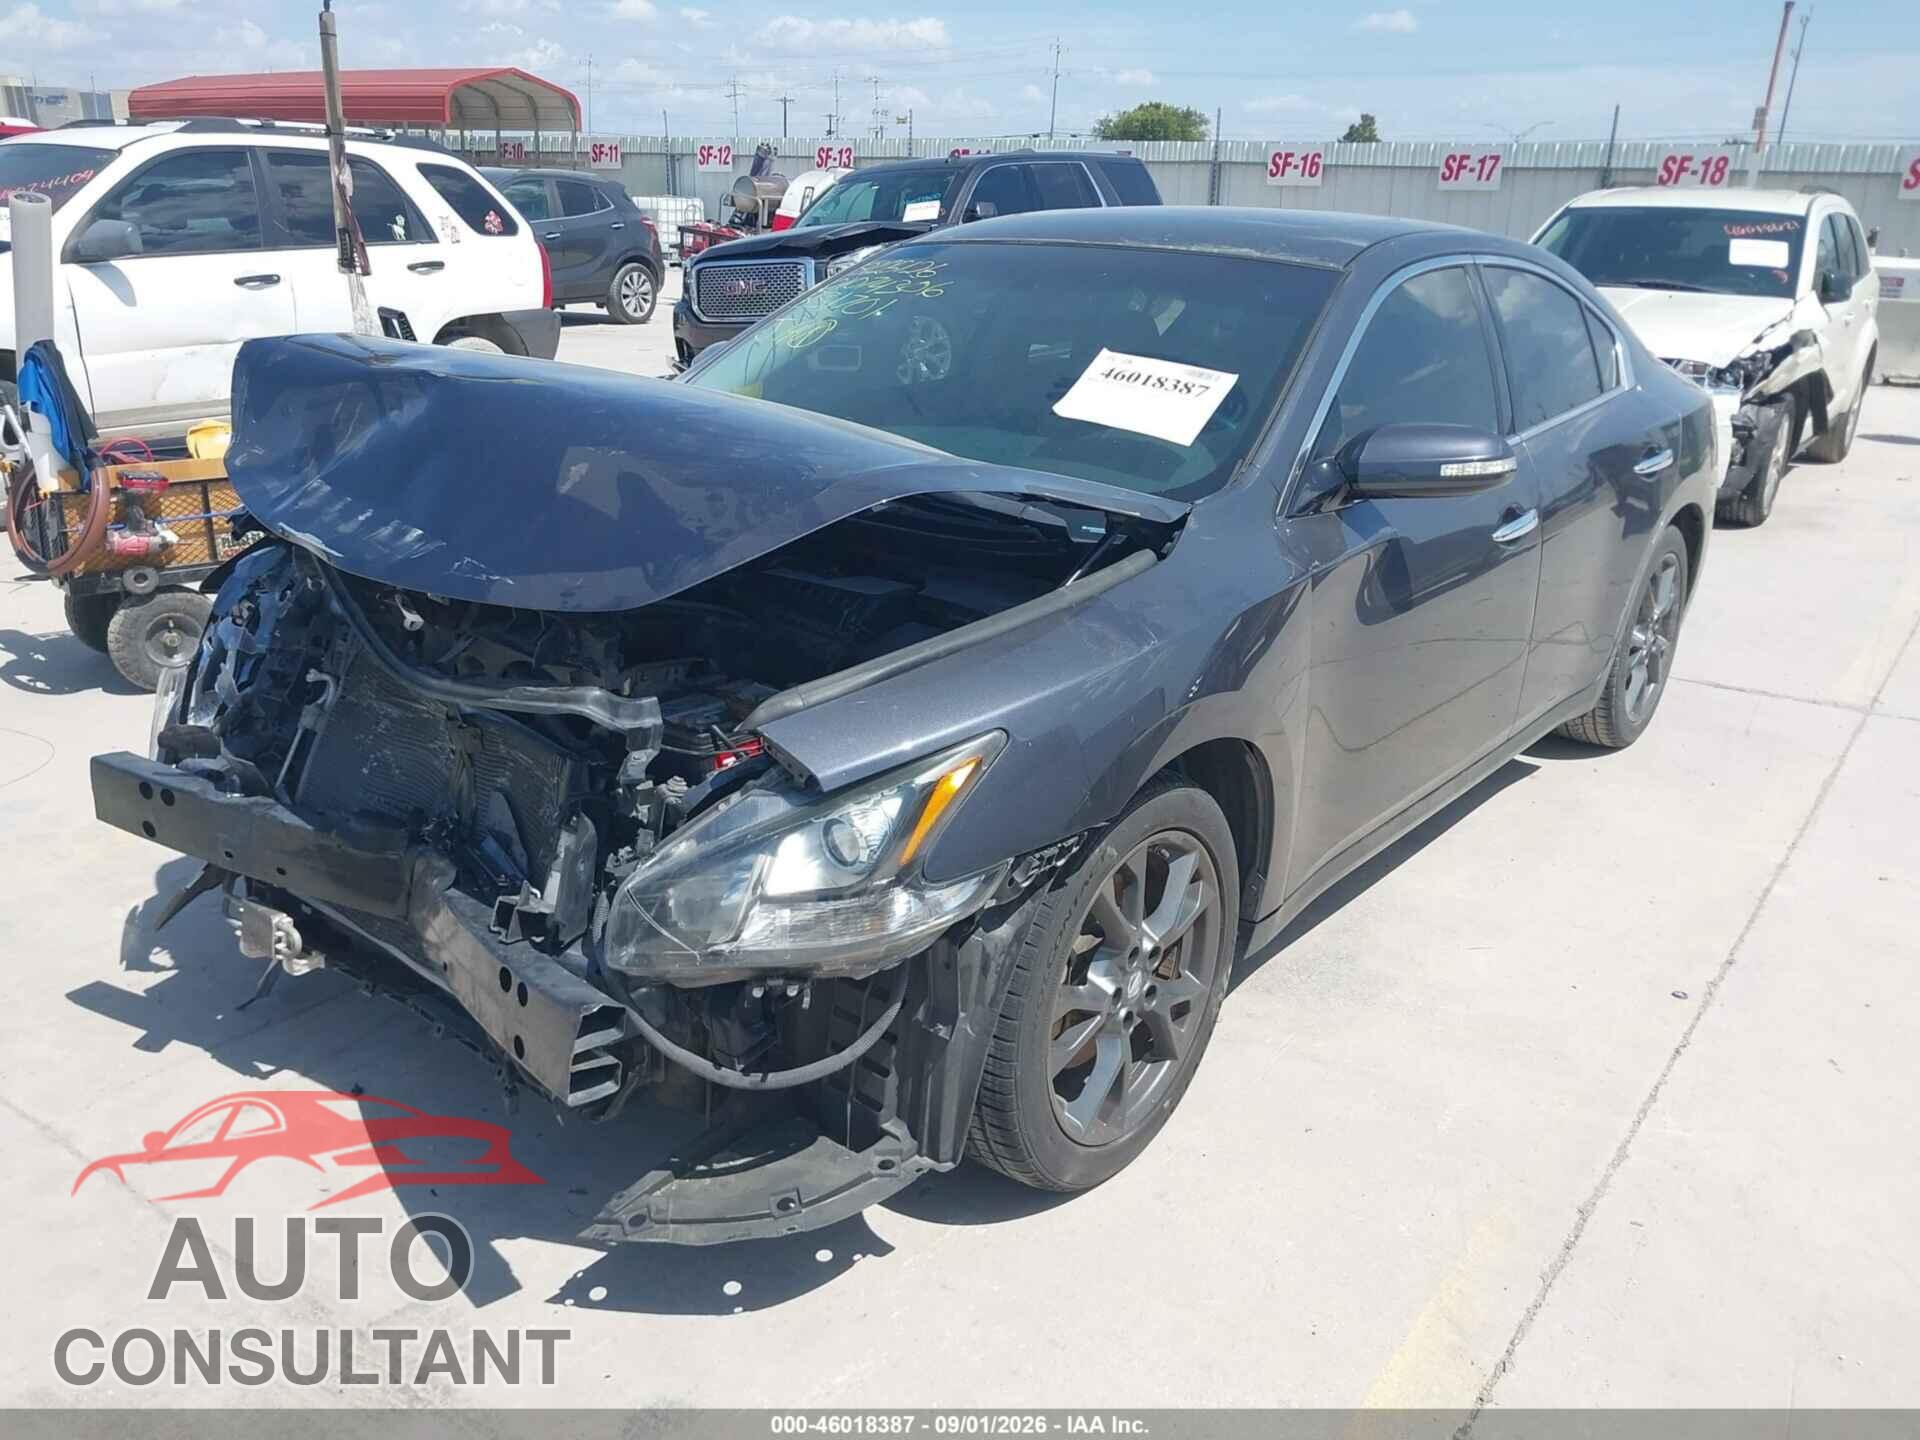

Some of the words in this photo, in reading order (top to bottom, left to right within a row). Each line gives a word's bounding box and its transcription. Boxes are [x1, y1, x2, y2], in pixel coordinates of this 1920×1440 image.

[500, 142, 524, 160] F-10
[591, 143, 619, 162] SF-11
[698, 145, 731, 166] SF-12
[816, 147, 852, 168] SF-13
[1269, 152, 1322, 178] SF-16
[1441, 154, 1501, 182] SF-17
[1658, 155, 1729, 186] SF-18
[1099, 367, 1211, 397] 46018387
